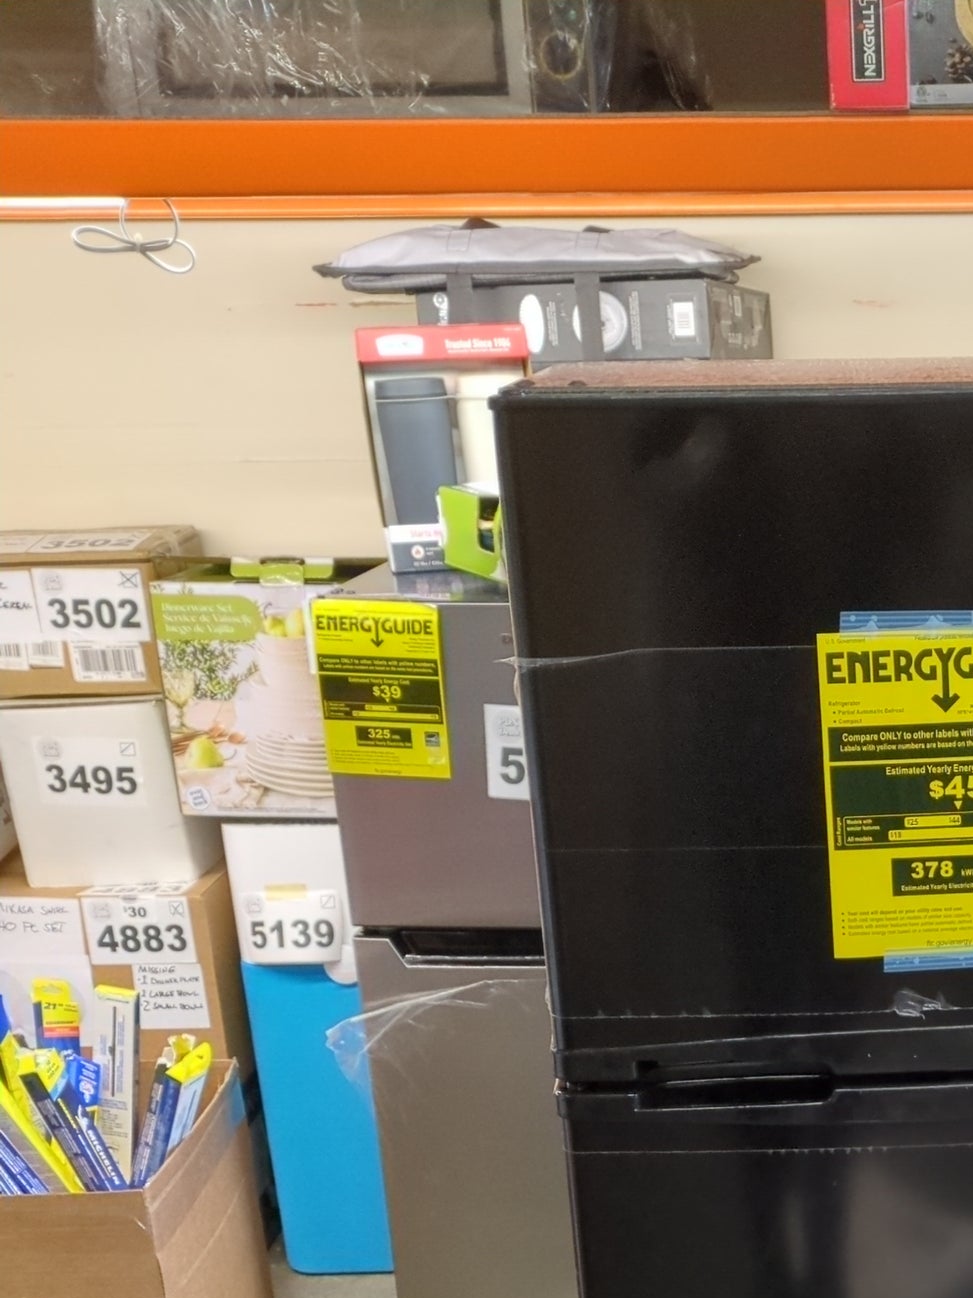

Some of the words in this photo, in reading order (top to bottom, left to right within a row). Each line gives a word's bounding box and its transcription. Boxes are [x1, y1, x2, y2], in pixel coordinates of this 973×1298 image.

[48, 598, 141, 629] 3502
[315, 614, 434, 636] ENERGYGUIDE
[372, 685, 401, 699] $39
[368, 728, 391, 739] 325
[842, 733, 878, 743] Compare
[879, 731, 902, 741] ONLY
[903, 732, 912, 740] to
[913, 730, 934, 740] other
[935, 729, 959, 739] labels
[840, 744, 861, 753] Labels
[862, 743, 876, 752] with
[876, 743, 897, 753] yellow
[897, 742, 925, 751] numbers
[937, 740, 956, 749] based
[886, 765, 925, 776] Estimated
[926, 764, 952, 775] Yearly
[45, 764, 138, 796] 3495
[911, 860, 954, 879] 378
[901, 884, 930, 892] Estimated
[930, 883, 947, 891] Yearly
[97, 924, 188, 953] 4883
[250, 919, 335, 950] 5139
[86, 1128, 121, 1186] MICHELIN
